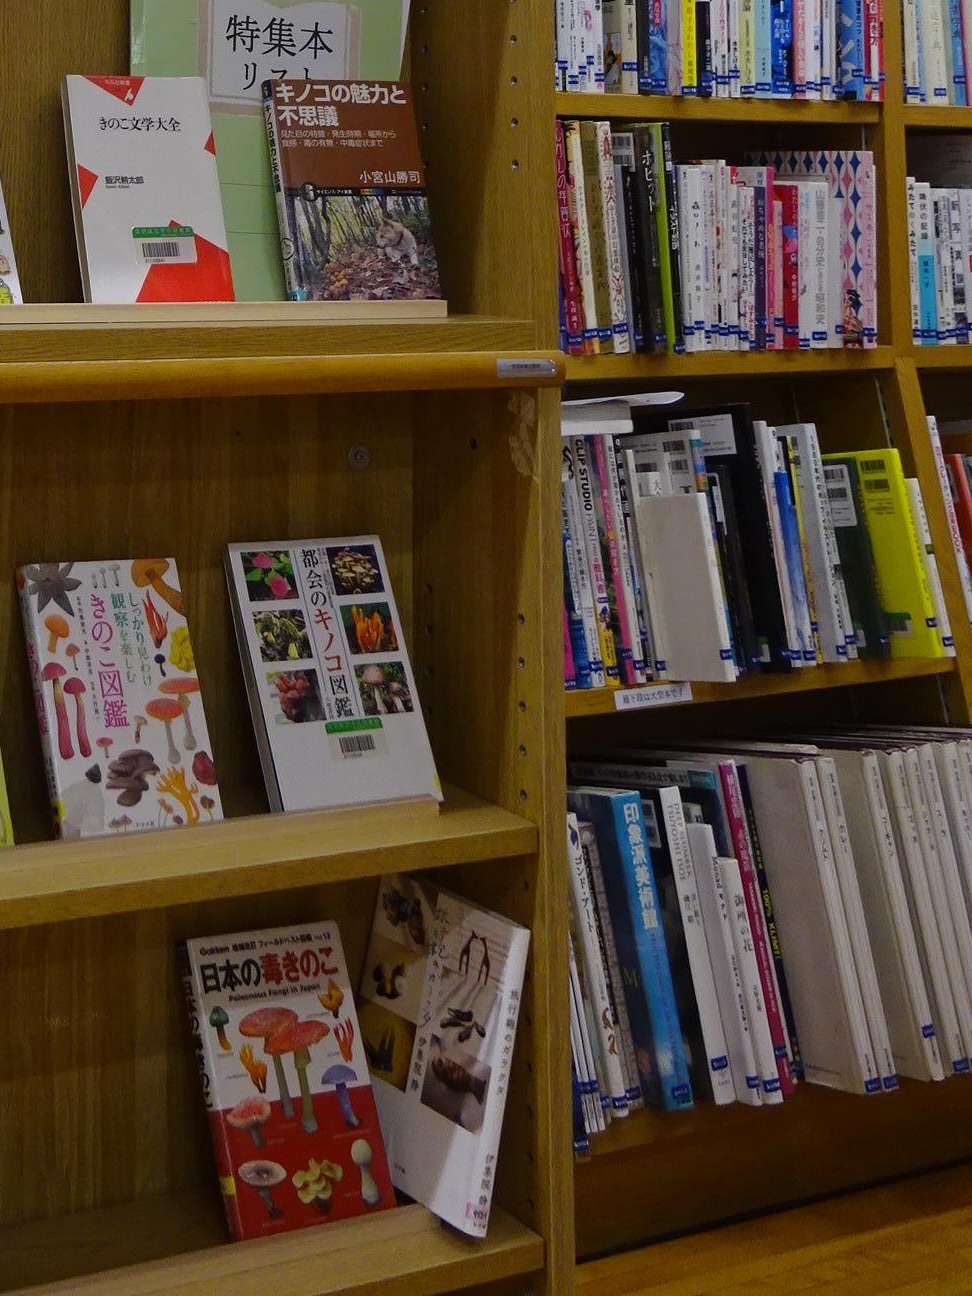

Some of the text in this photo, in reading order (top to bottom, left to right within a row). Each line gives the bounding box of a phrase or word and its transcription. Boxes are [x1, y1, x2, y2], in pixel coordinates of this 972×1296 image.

[225, 13, 334, 60] 特集本
[275, 83, 407, 104] キノコの魅力と
[277, 105, 340, 127] 不思議
[99, 116, 181, 132] きのこ文学大全
[359, 170, 421, 184] 小宮山勝司
[641, 149, 655, 213] ホビット
[575, 438, 586, 466] CLIP
[579, 467, 593, 511] STUDIO
[111, 592, 137, 684] 観察を楽しむ
[128, 592, 152, 687] しっかり見わけ
[301, 548, 355, 718] 都会のキノコ図鑑
[90, 593, 131, 729] きのこ図鑑
[199, 945, 339, 995] 日本の毒きのこ
[268, 988, 289, 999] Fungi
[299, 983, 321, 994] Japan
